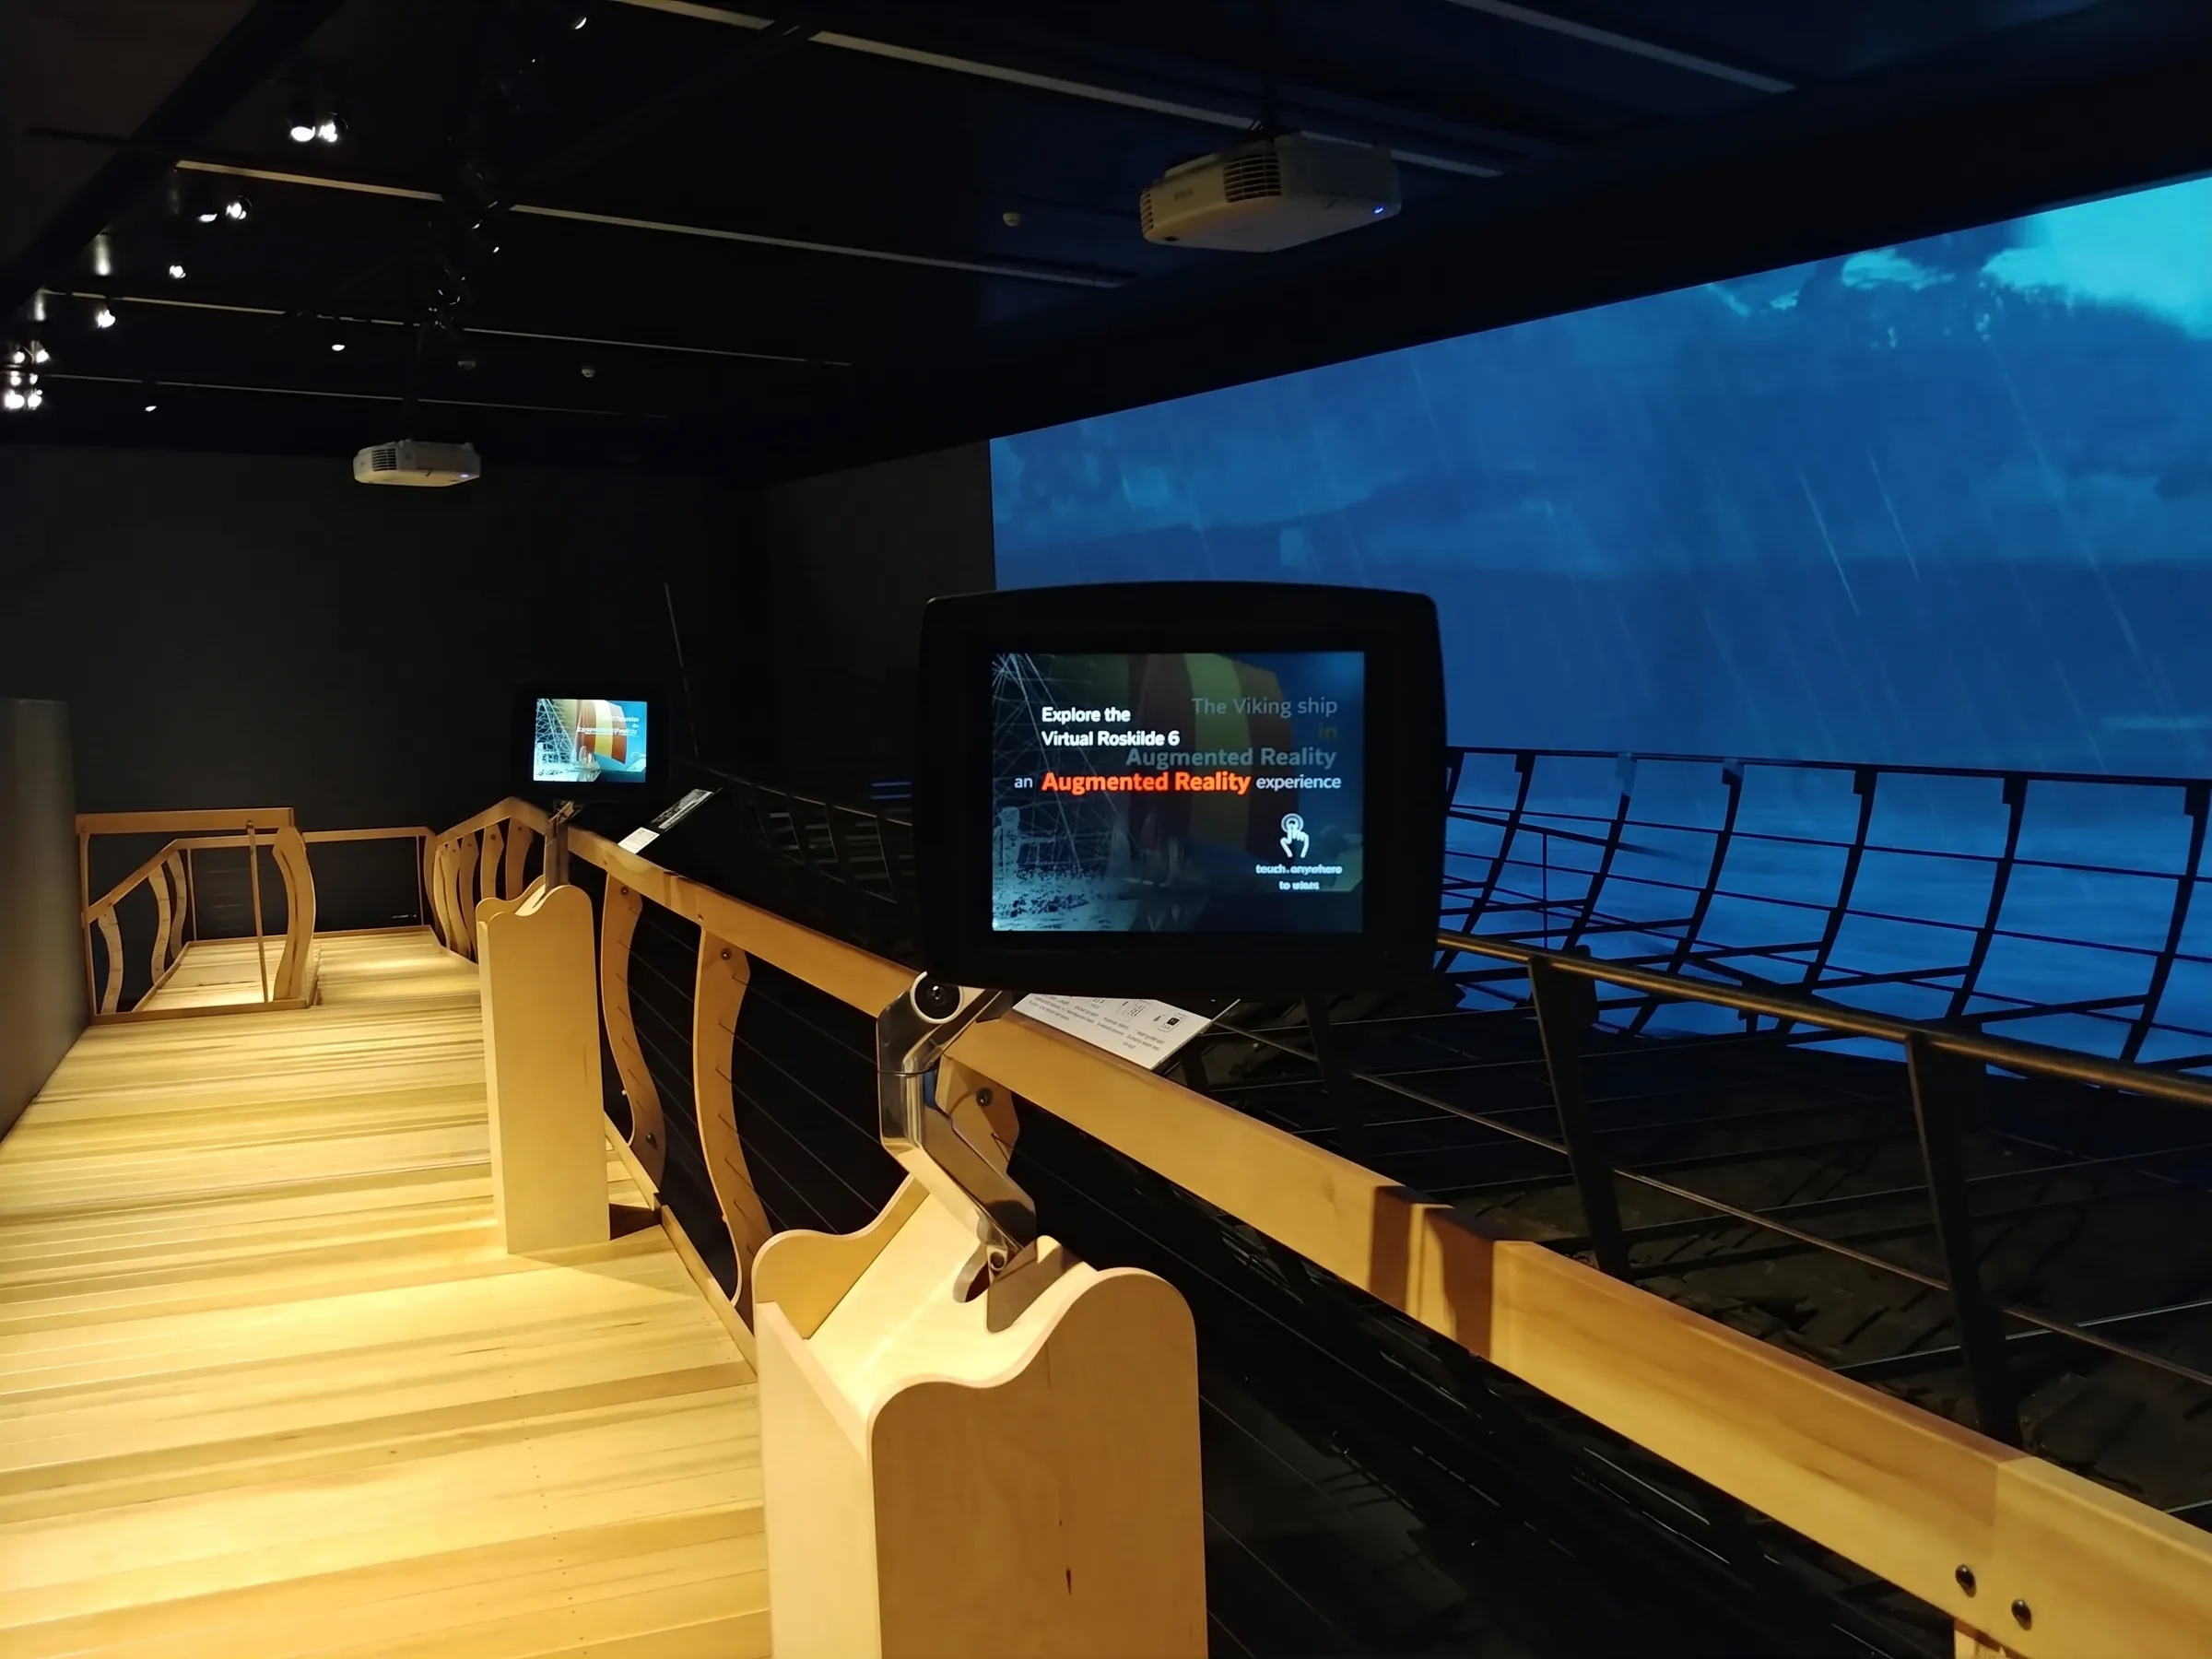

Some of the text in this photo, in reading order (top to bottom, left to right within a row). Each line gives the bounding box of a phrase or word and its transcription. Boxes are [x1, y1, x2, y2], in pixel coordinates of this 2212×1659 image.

[1041, 707, 1131, 724] Explore the
[1192, 697, 1338, 719] The Viking ship
[1041, 730, 1181, 747] Virtual Roskilde 6
[1125, 747, 1336, 771] Augmented Reality
[1014, 771, 1342, 795] an Augmented Reality experience
